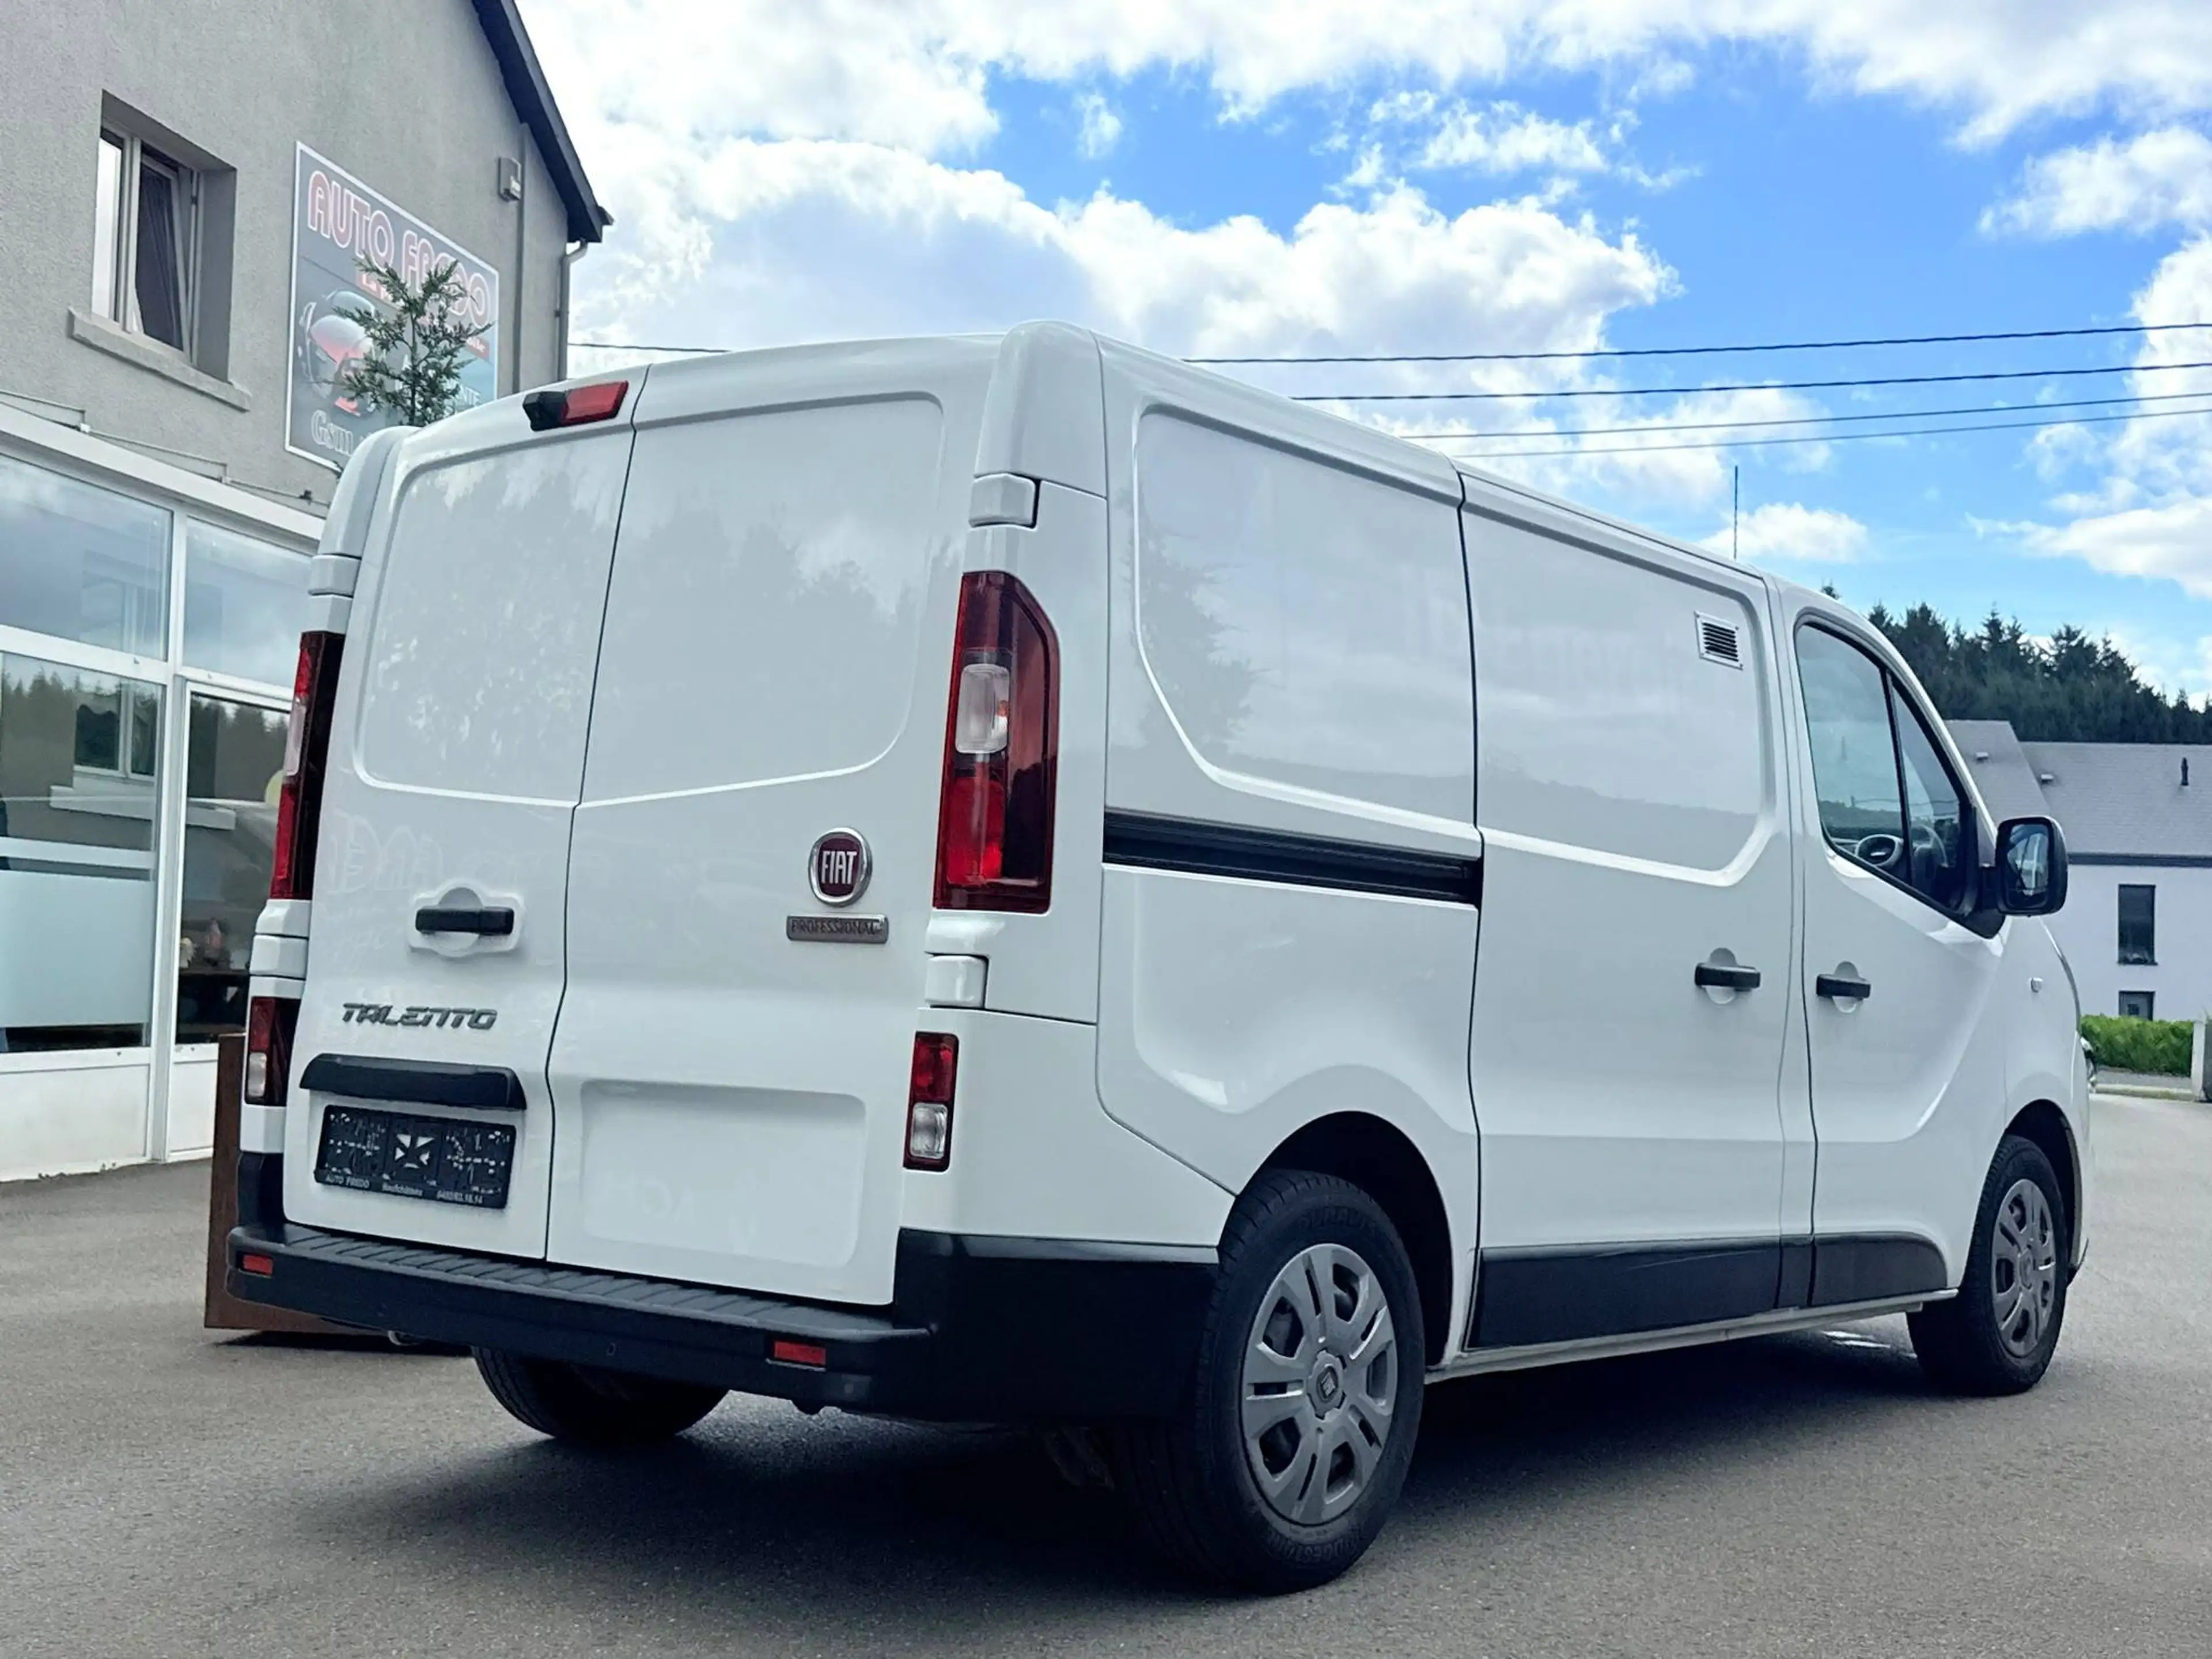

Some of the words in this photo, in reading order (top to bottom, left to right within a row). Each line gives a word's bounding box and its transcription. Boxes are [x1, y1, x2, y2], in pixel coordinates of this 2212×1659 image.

[308, 170, 395, 273] AUTO
[821, 850, 857, 884] FIAT
[791, 919, 883, 934] PROFESSIONAL
[343, 1002, 497, 1030] TALENTO
